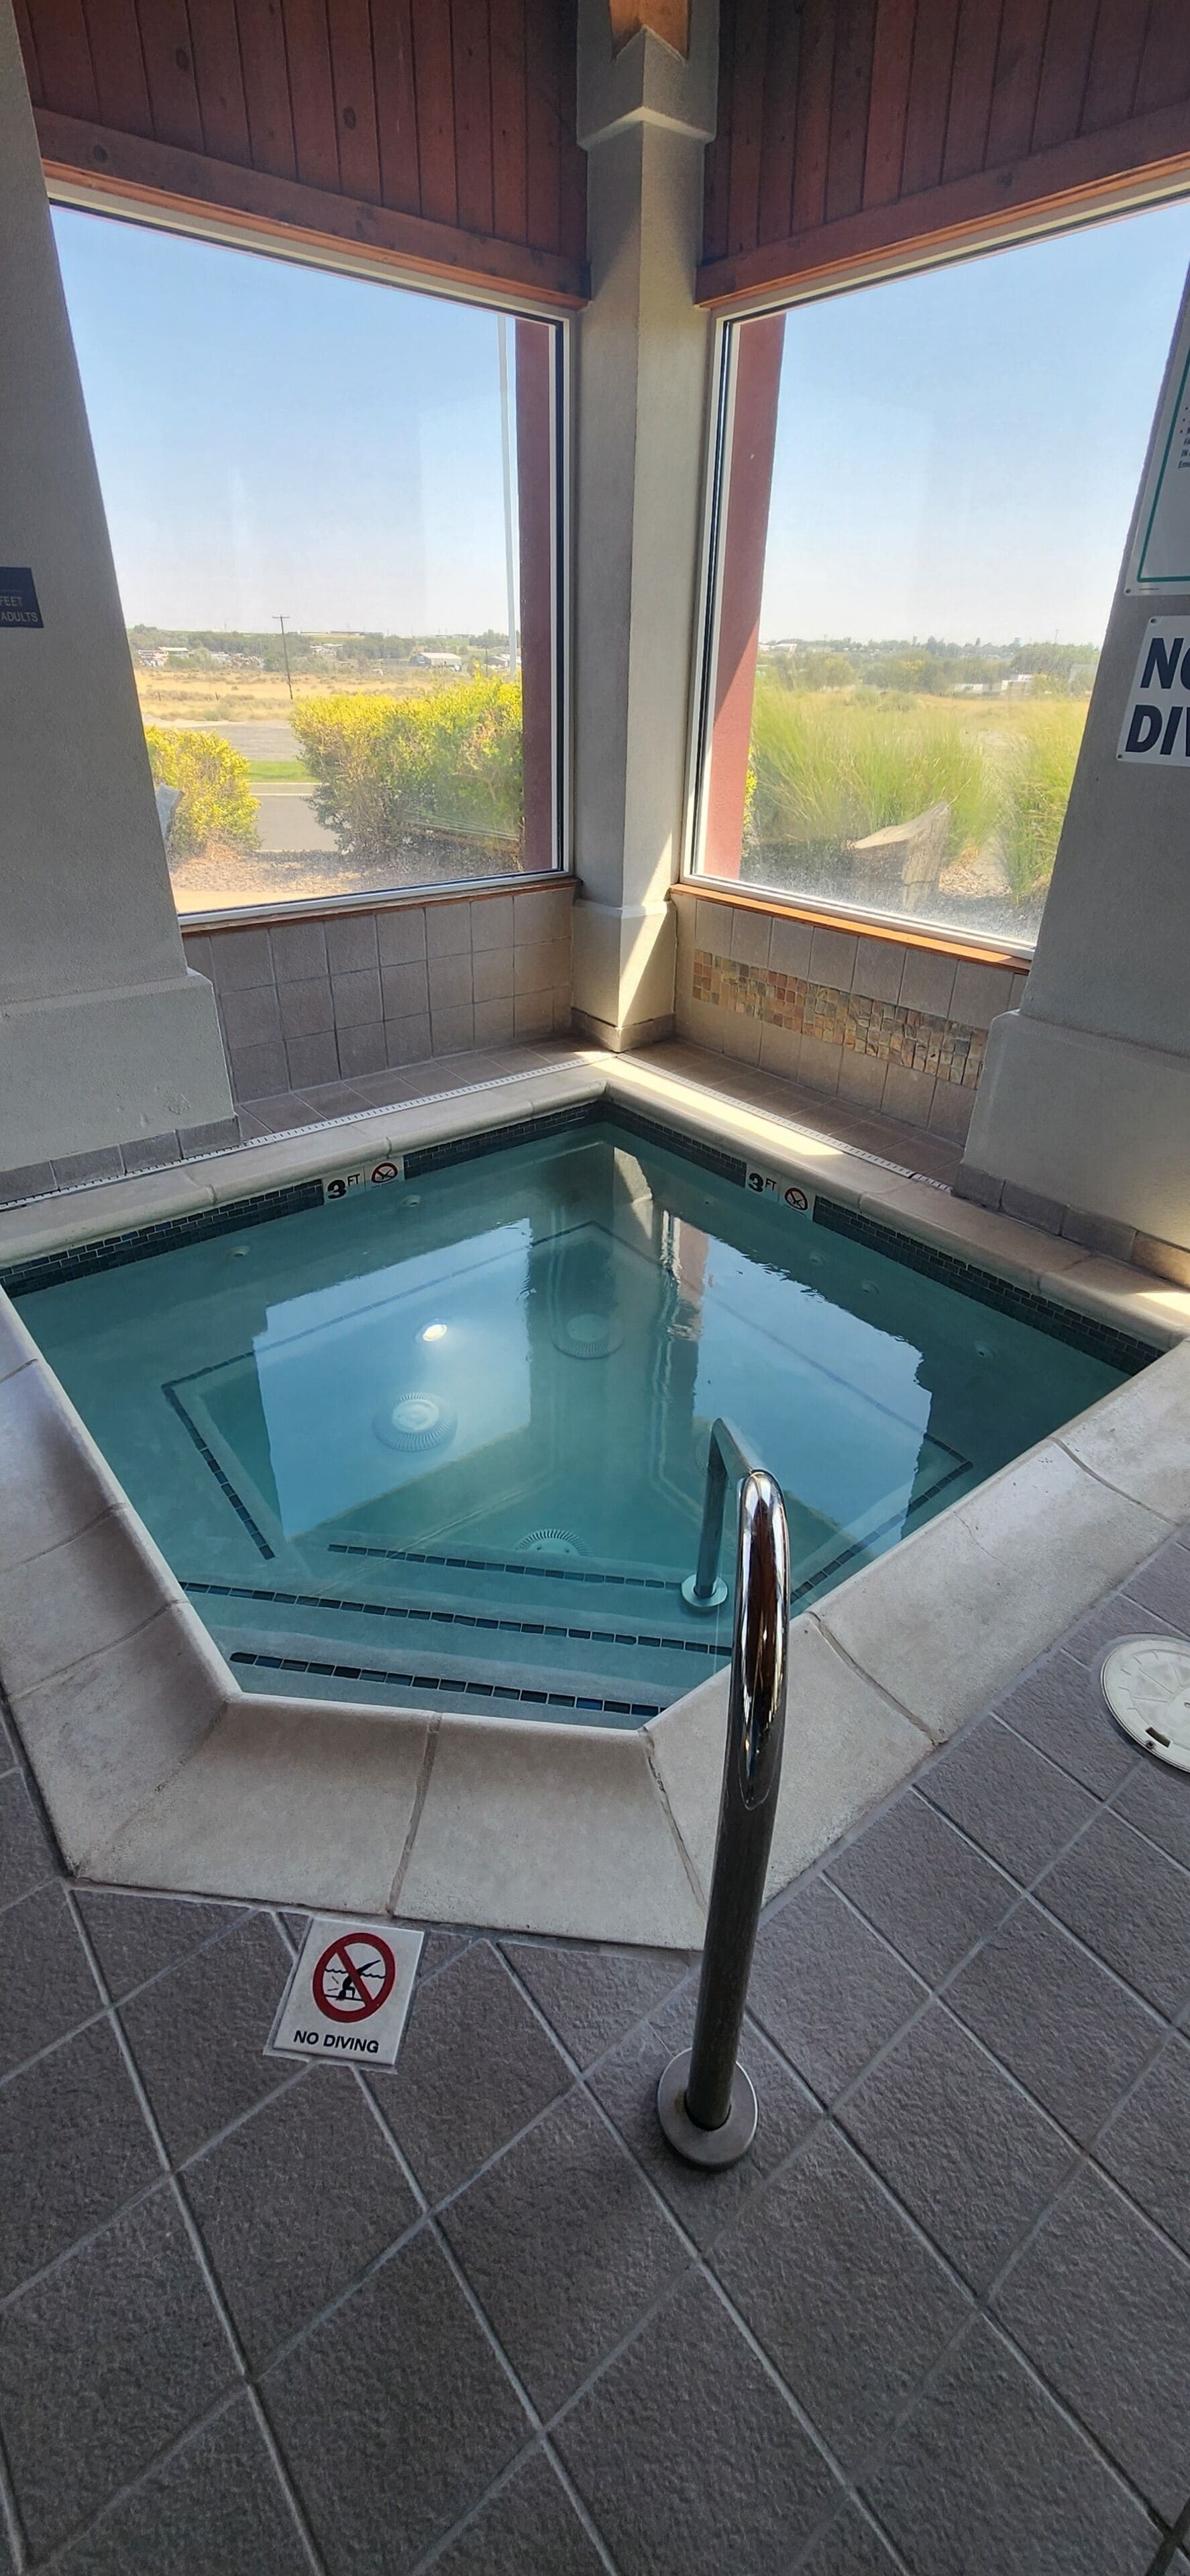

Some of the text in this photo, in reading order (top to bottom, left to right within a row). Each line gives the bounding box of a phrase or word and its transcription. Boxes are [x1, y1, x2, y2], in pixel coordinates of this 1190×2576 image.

[1, 611, 38, 623] ADULTS
[327, 1179, 347, 1199] 3
[347, 1173, 360, 1186] FT
[749, 1173, 777, 1193] 3 FT
[293, 2030, 380, 2053] NO DIVING
